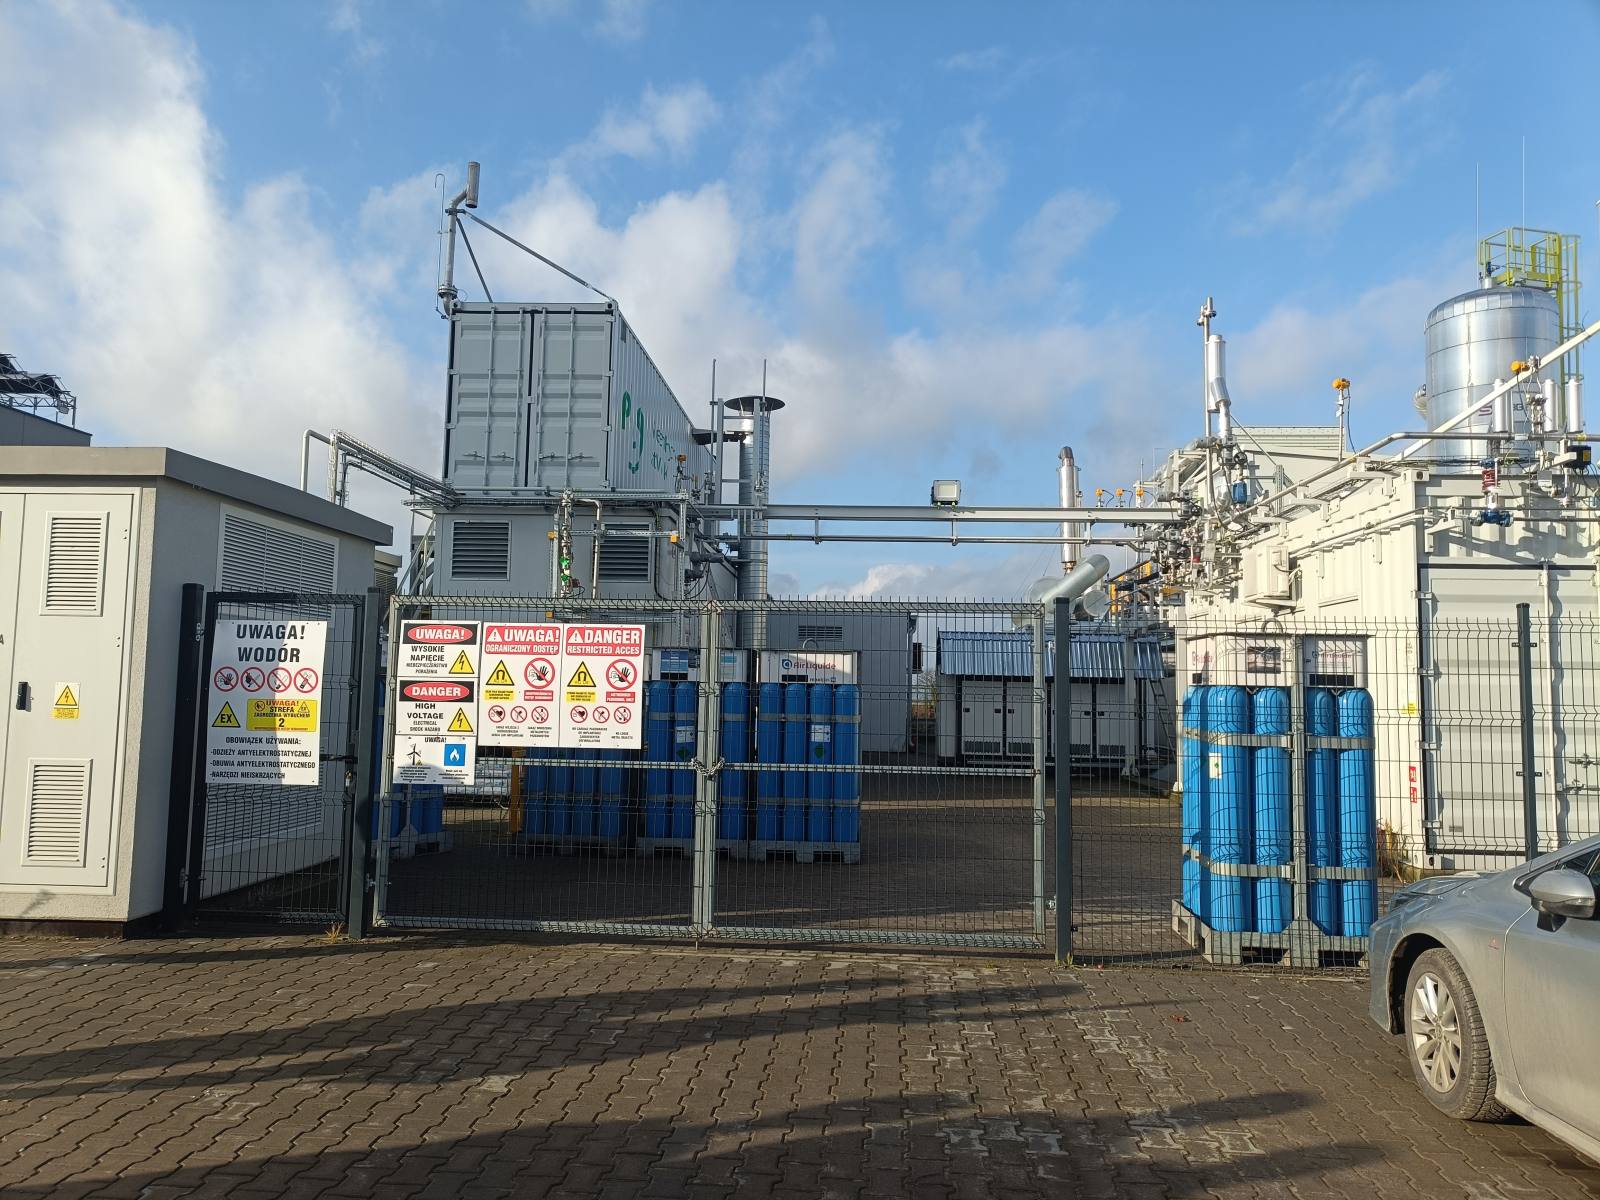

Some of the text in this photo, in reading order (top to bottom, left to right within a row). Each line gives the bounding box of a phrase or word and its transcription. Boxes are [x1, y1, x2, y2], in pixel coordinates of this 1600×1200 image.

[236, 624, 306, 640] UWAGA!
[415, 629, 465, 639] UWAGA!
[504, 629, 560, 643] UWAGA!
[584, 629, 640, 644] DANGER
[238, 644, 301, 663] WODÓR
[486, 644, 559, 654] OGRANICZONY DOSTĘP
[567, 645, 640, 654] RESTRICTED ACCES
[411, 686, 461, 697] DANGER
[220, 714, 232, 724] EX
[278, 718, 285, 728] 2
[226, 736, 301, 745] OBOWIĄZEK UŻYWANIA:
[238, 749, 312, 757] ANTYELEKTROSTATYCZNEJ
[236, 760, 316, 769] ANTYELEKTROSTATYCZNEGO
